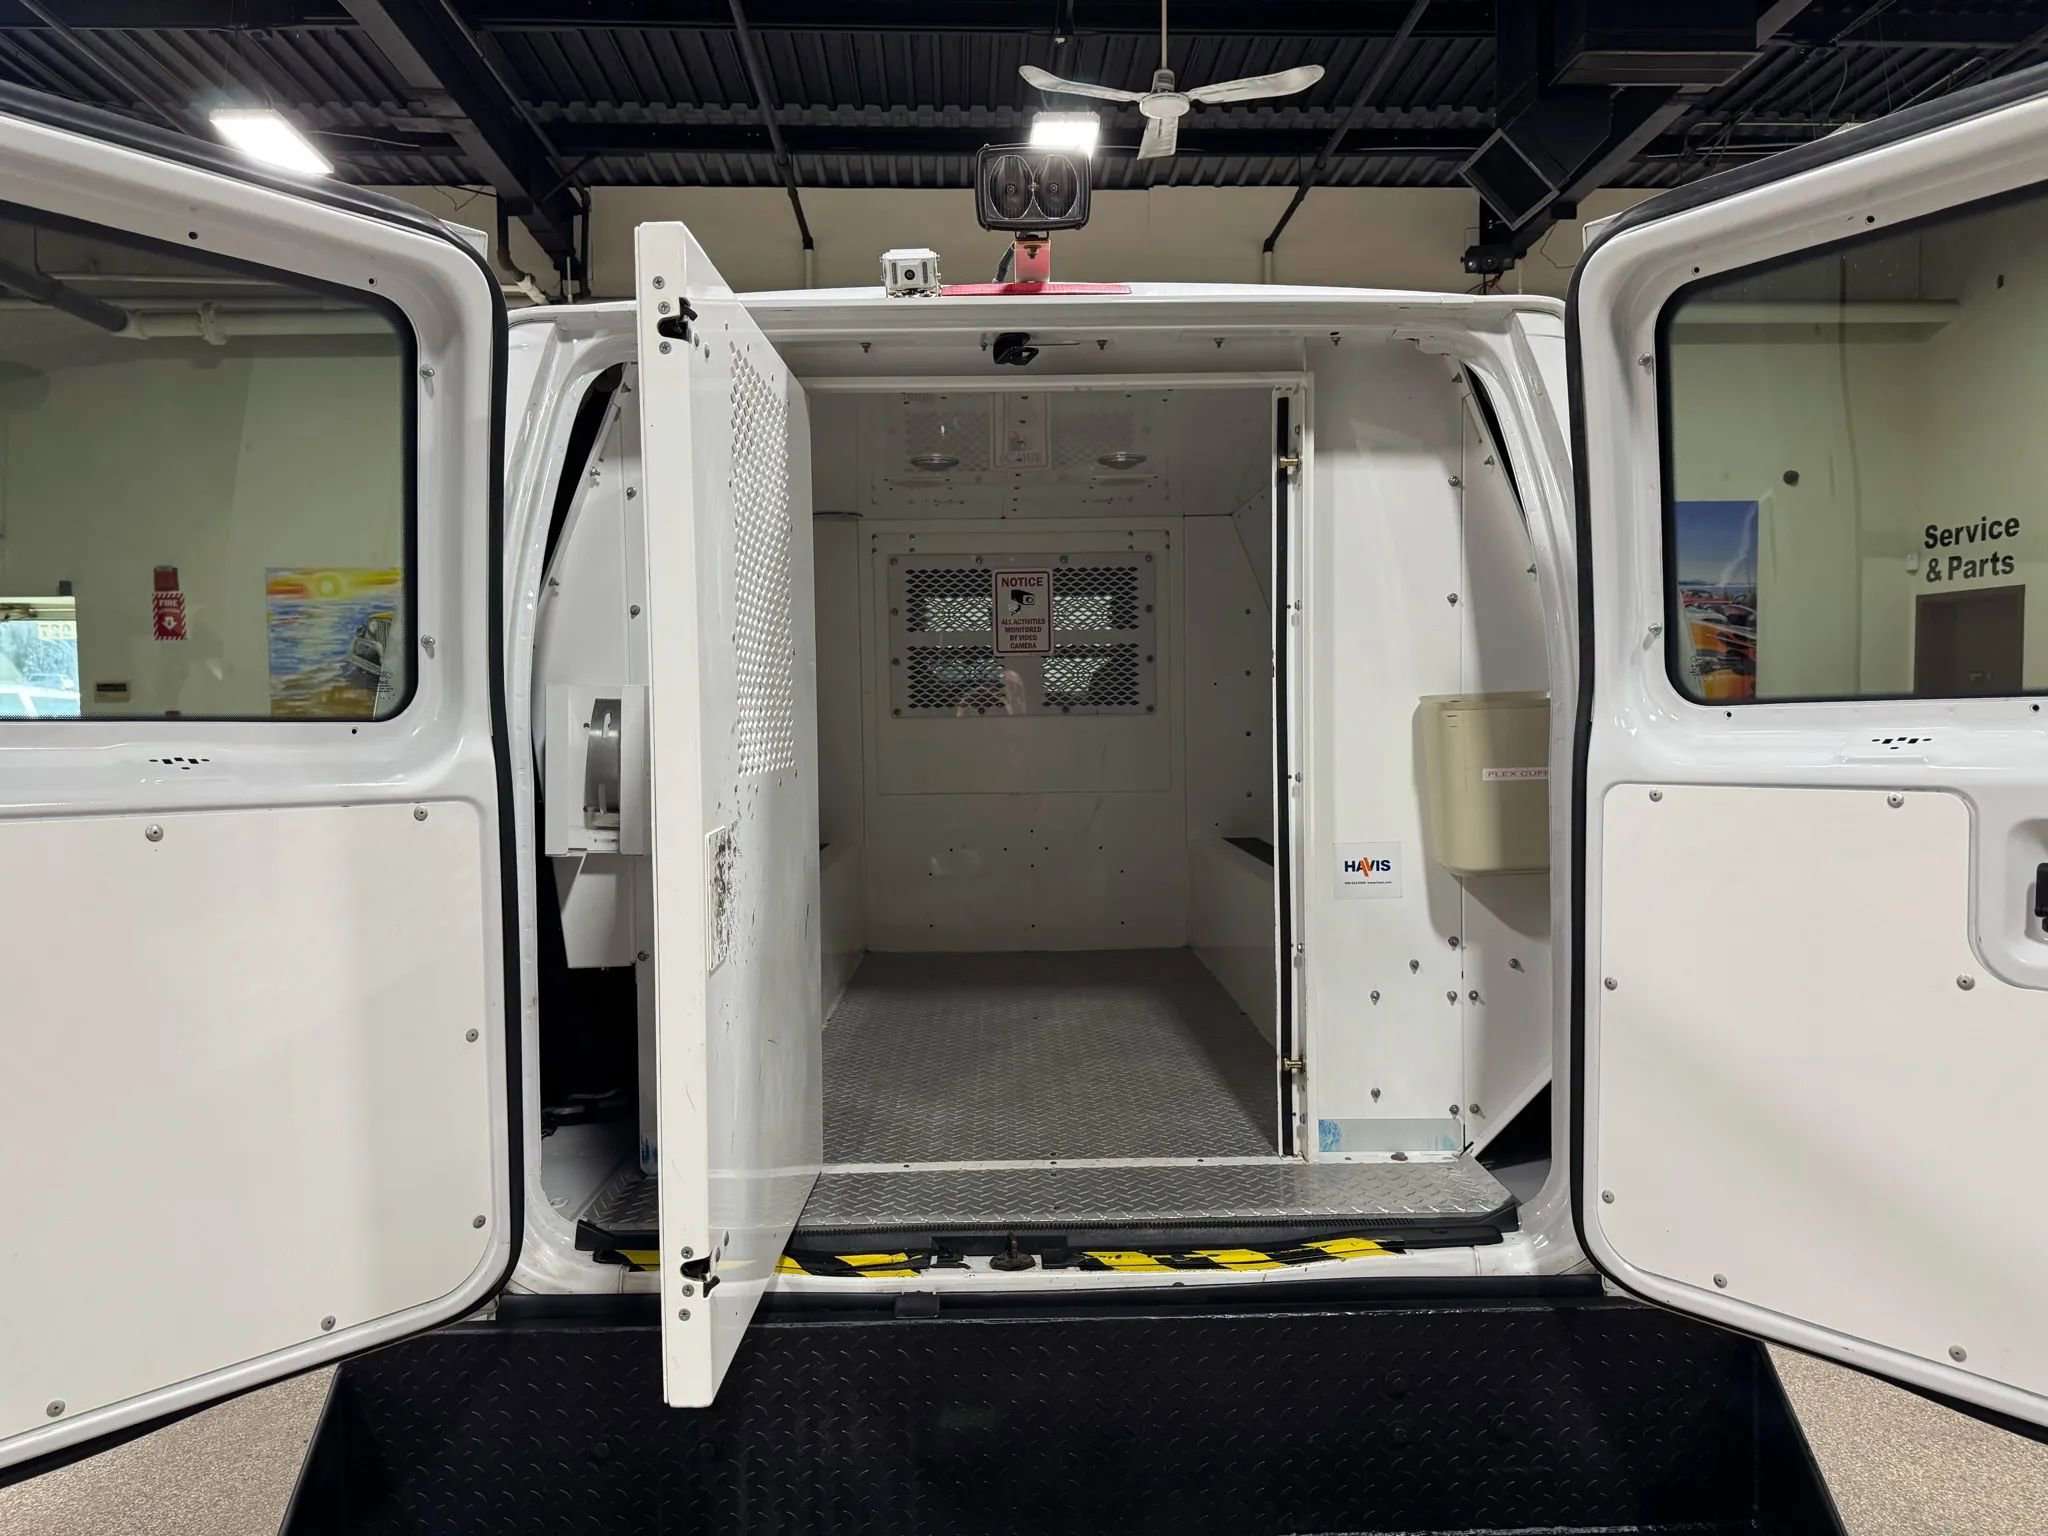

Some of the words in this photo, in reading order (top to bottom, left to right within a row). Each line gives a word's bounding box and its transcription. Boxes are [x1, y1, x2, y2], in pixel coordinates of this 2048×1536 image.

[1924, 515, 2020, 549] Service
[1926, 558, 1942, 582] &
[1948, 551, 2015, 580] Parts
[1001, 577, 1044, 587] NOTICE
[159, 599, 178, 607] FIRE
[1344, 857, 1391, 877] HAVIS
